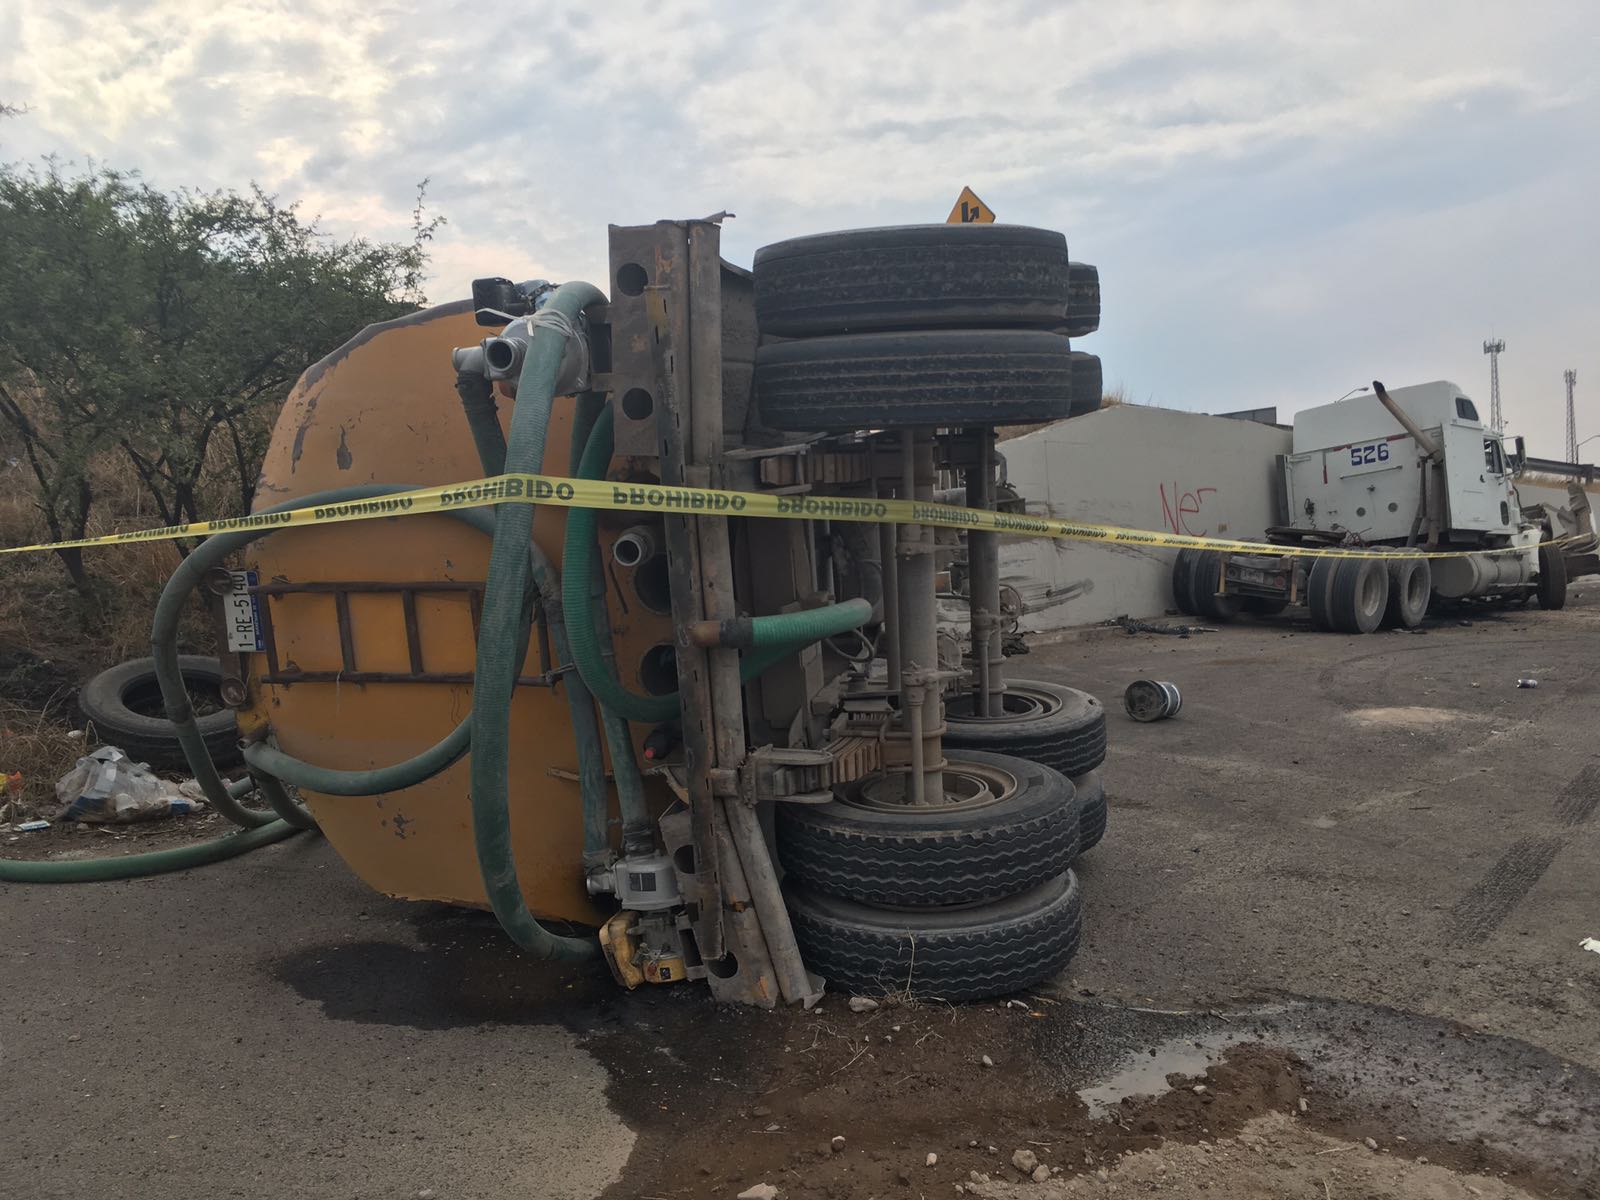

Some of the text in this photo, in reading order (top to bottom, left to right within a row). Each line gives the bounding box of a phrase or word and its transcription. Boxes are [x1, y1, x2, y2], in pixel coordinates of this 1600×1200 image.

[1351, 443, 1389, 466] 526
[314, 496, 413, 520] PROHIBIDO
[440, 478, 575, 507] PROHIBIDO
[613, 487, 747, 511] PROHIBIDO
[777, 496, 887, 517] PROHIBIDO
[913, 504, 979, 526] PROHIBIDO
[993, 513, 1050, 533] PROHIBIDO
